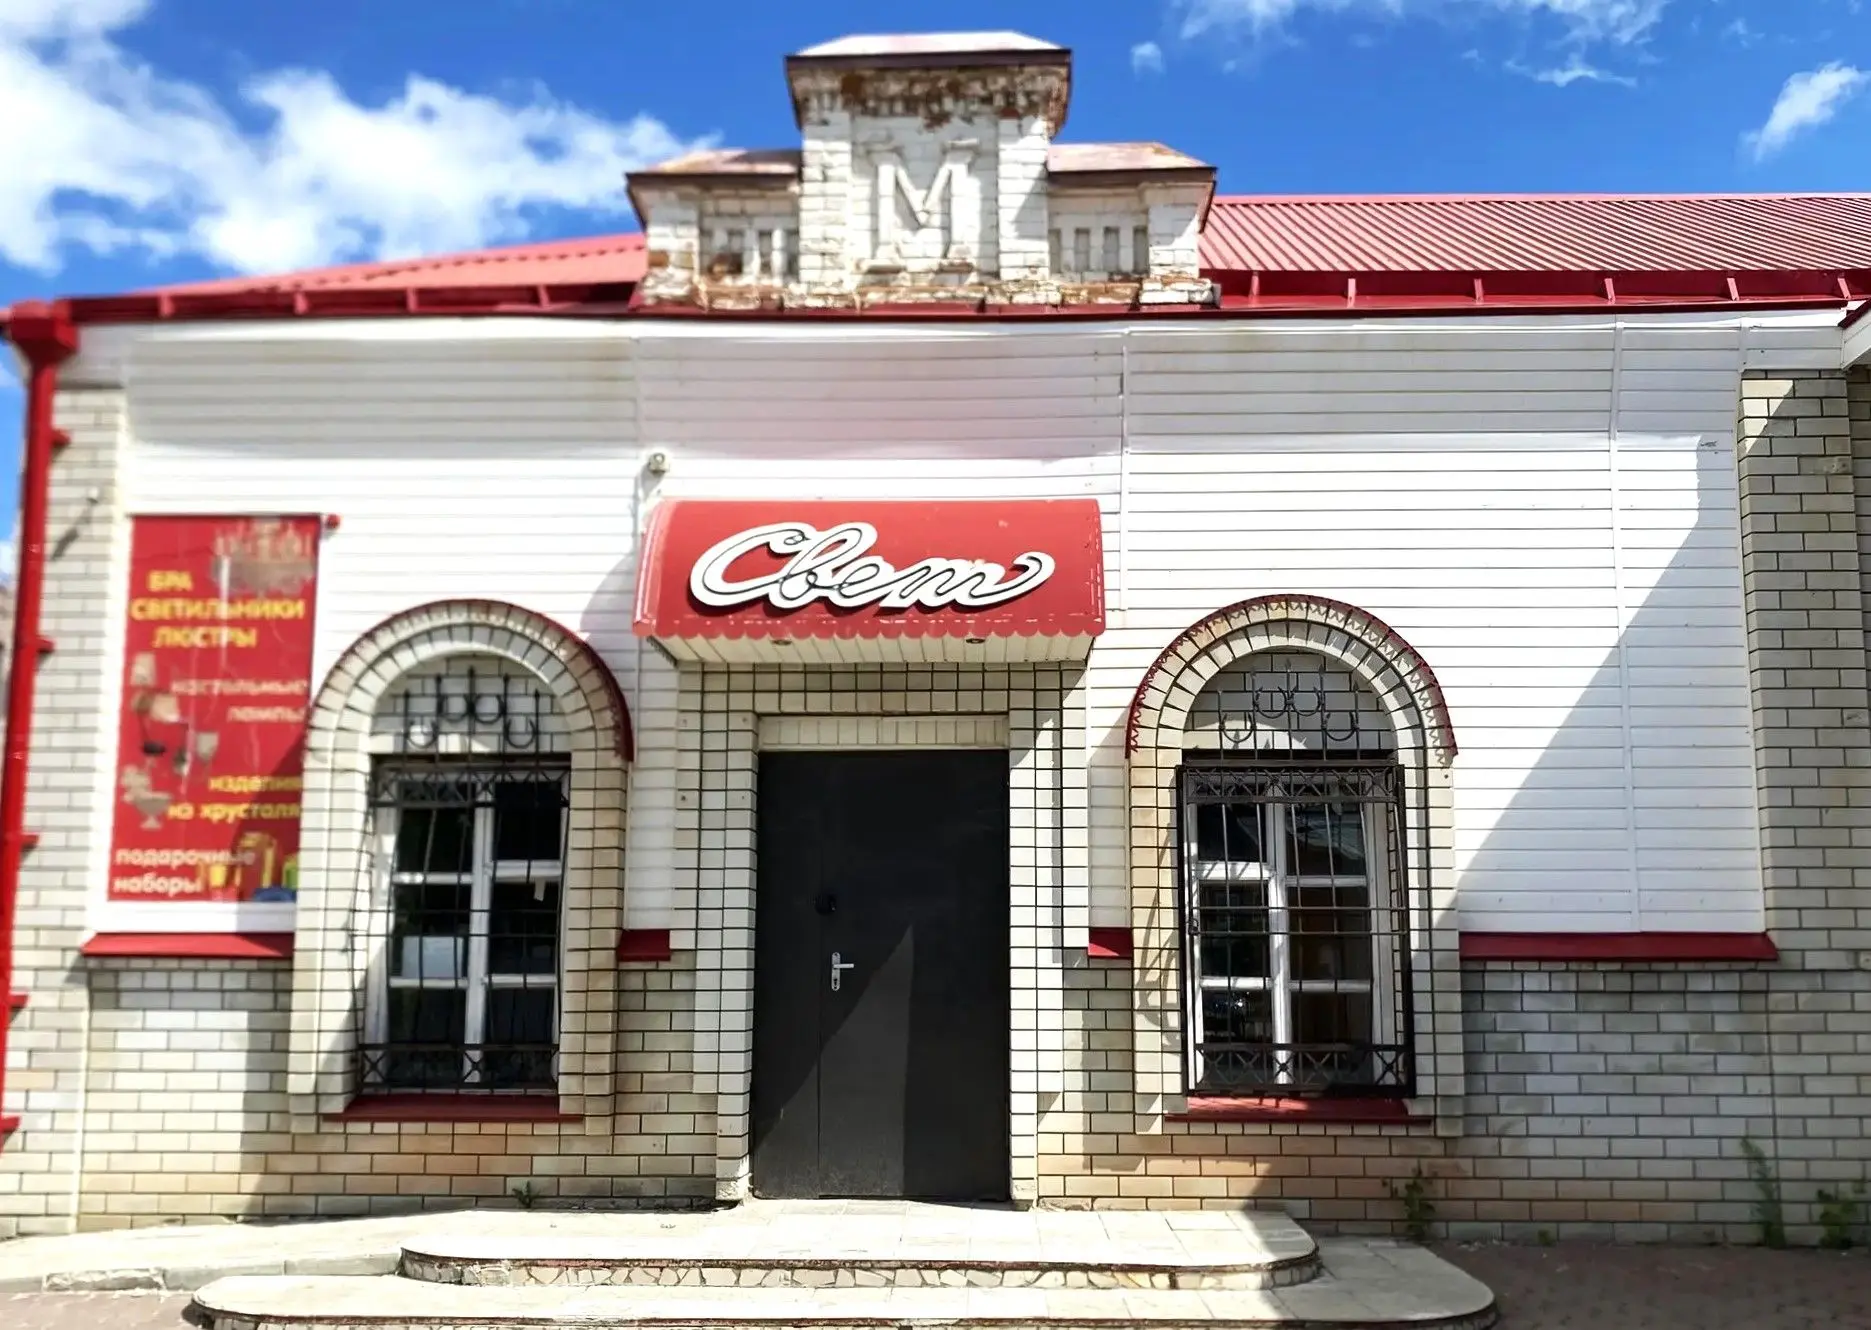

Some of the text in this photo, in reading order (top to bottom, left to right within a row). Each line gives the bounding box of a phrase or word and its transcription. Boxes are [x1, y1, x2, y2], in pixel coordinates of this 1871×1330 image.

[690, 522, 1056, 608] Свет
[148, 570, 193, 592] БРА
[153, 626, 257, 648] ЛЮСТРЫ
[113, 872, 204, 898] наборы
